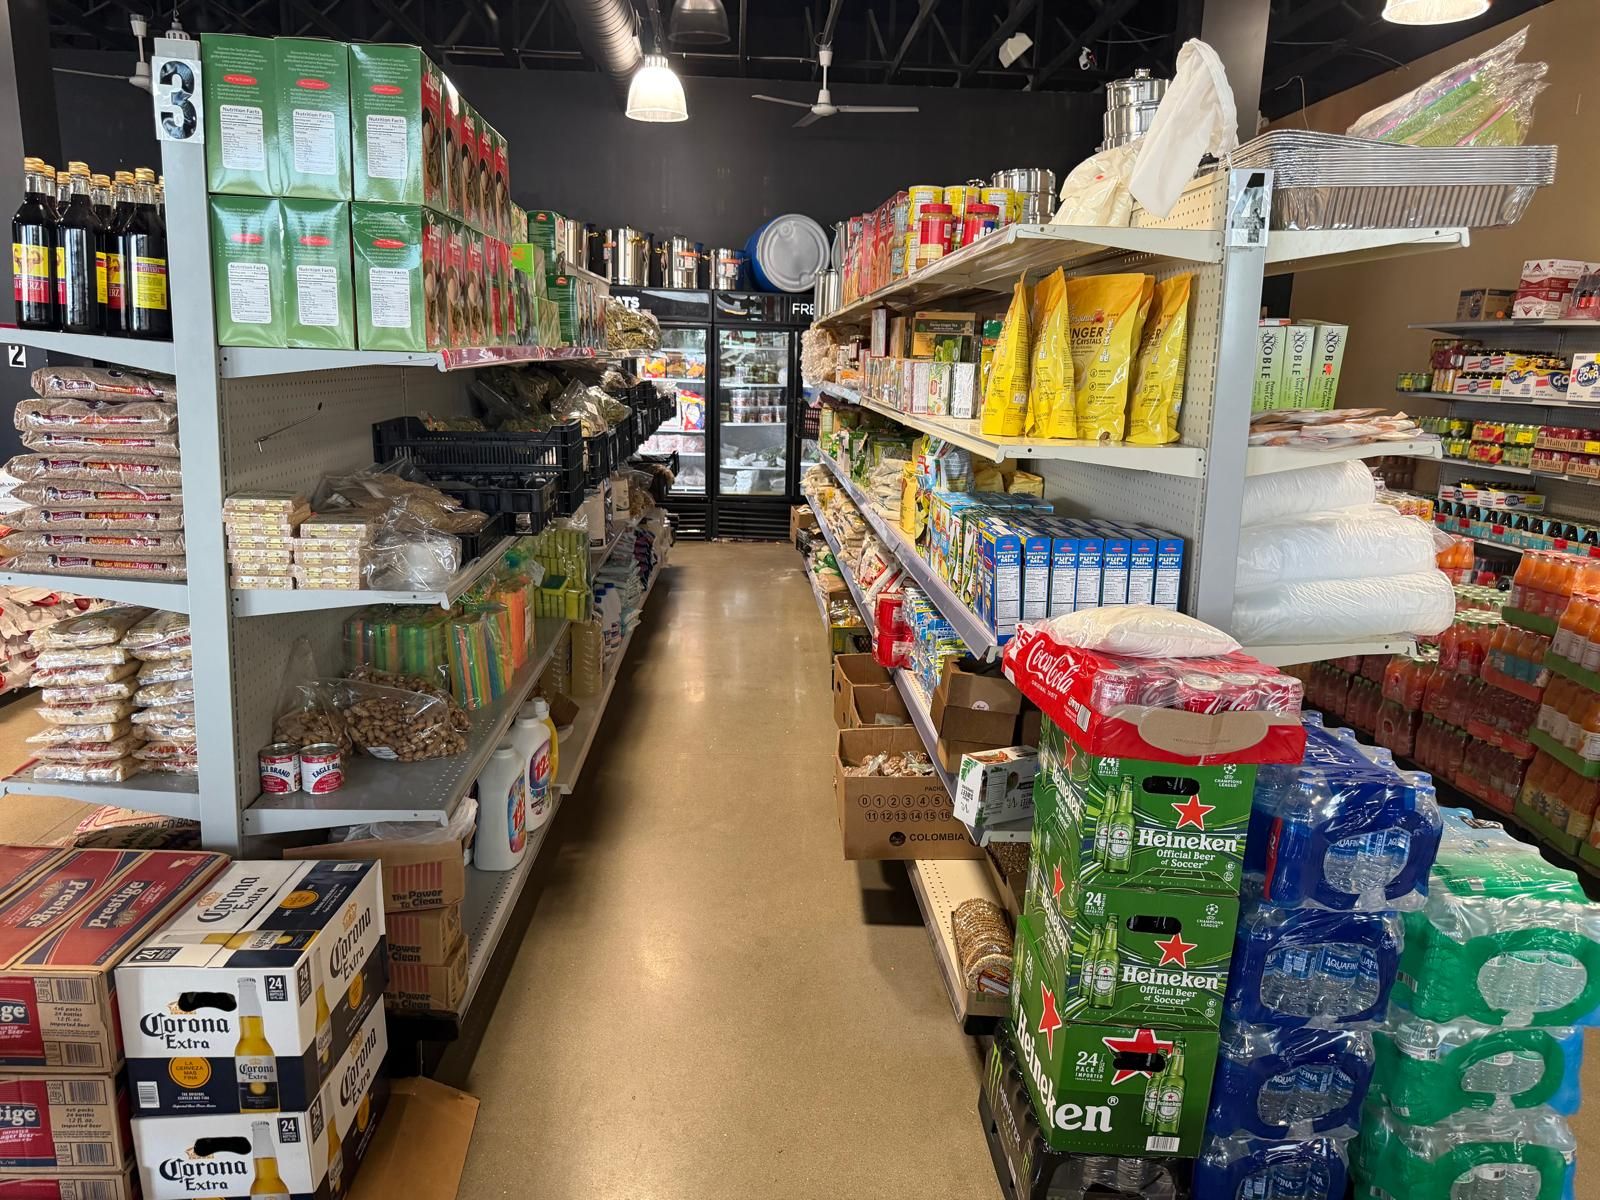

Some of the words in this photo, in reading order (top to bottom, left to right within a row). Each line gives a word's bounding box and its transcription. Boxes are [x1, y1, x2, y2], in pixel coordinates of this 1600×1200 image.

[160, 61, 197, 139] 3
[1231, 172, 1266, 243] 4
[12, 346, 24, 366] 2
[1261, 335, 1275, 379] NOBLE
[1292, 334, 1305, 375] NOBLE
[1026, 639, 1080, 695] Coca-Cola
[270, 766, 291, 778] BRAND
[311, 765, 332, 778] EAGLE
[919, 797, 926, 805] 4
[934, 796, 941, 805] 5
[868, 812, 877, 820] 11
[882, 812, 892, 820] 12
[896, 812, 906, 820] 13
[910, 812, 921, 820] 14
[909, 833, 965, 841] COLOMBIA
[1137, 829, 1239, 852] Heineken
[1156, 849, 1191, 860] Official
[1193, 852, 1216, 861] Beer
[1170, 859, 1204, 869] Soccer
[197, 876, 261, 923] Corona
[231, 887, 269, 914] Extra
[408, 889, 443, 900] Power
[412, 897, 443, 907] Clean
[1085, 891, 1102, 906] 24
[26, 879, 87, 928] Prestige
[88, 881, 144, 929] Prestige
[329, 907, 372, 978] Corona
[341, 945, 364, 982] Extra
[391, 952, 421, 962] Clean
[268, 977, 283, 989] 24
[1122, 966, 1219, 990] Heineken
[1139, 986, 1174, 996] Official
[1175, 990, 1198, 998] Beer
[1153, 995, 1187, 1005] Soccer
[140, 1013, 230, 1039] Corona
[165, 1035, 210, 1049] Extra
[1076, 1051, 1098, 1066] 24
[239, 1064, 274, 1075] Corona
[340, 1027, 376, 1108] Corona
[351, 1068, 371, 1107] Extra
[281, 1120, 295, 1132] 24
[159, 1158, 248, 1183] Corona
[185, 1178, 229, 1191] Extra
